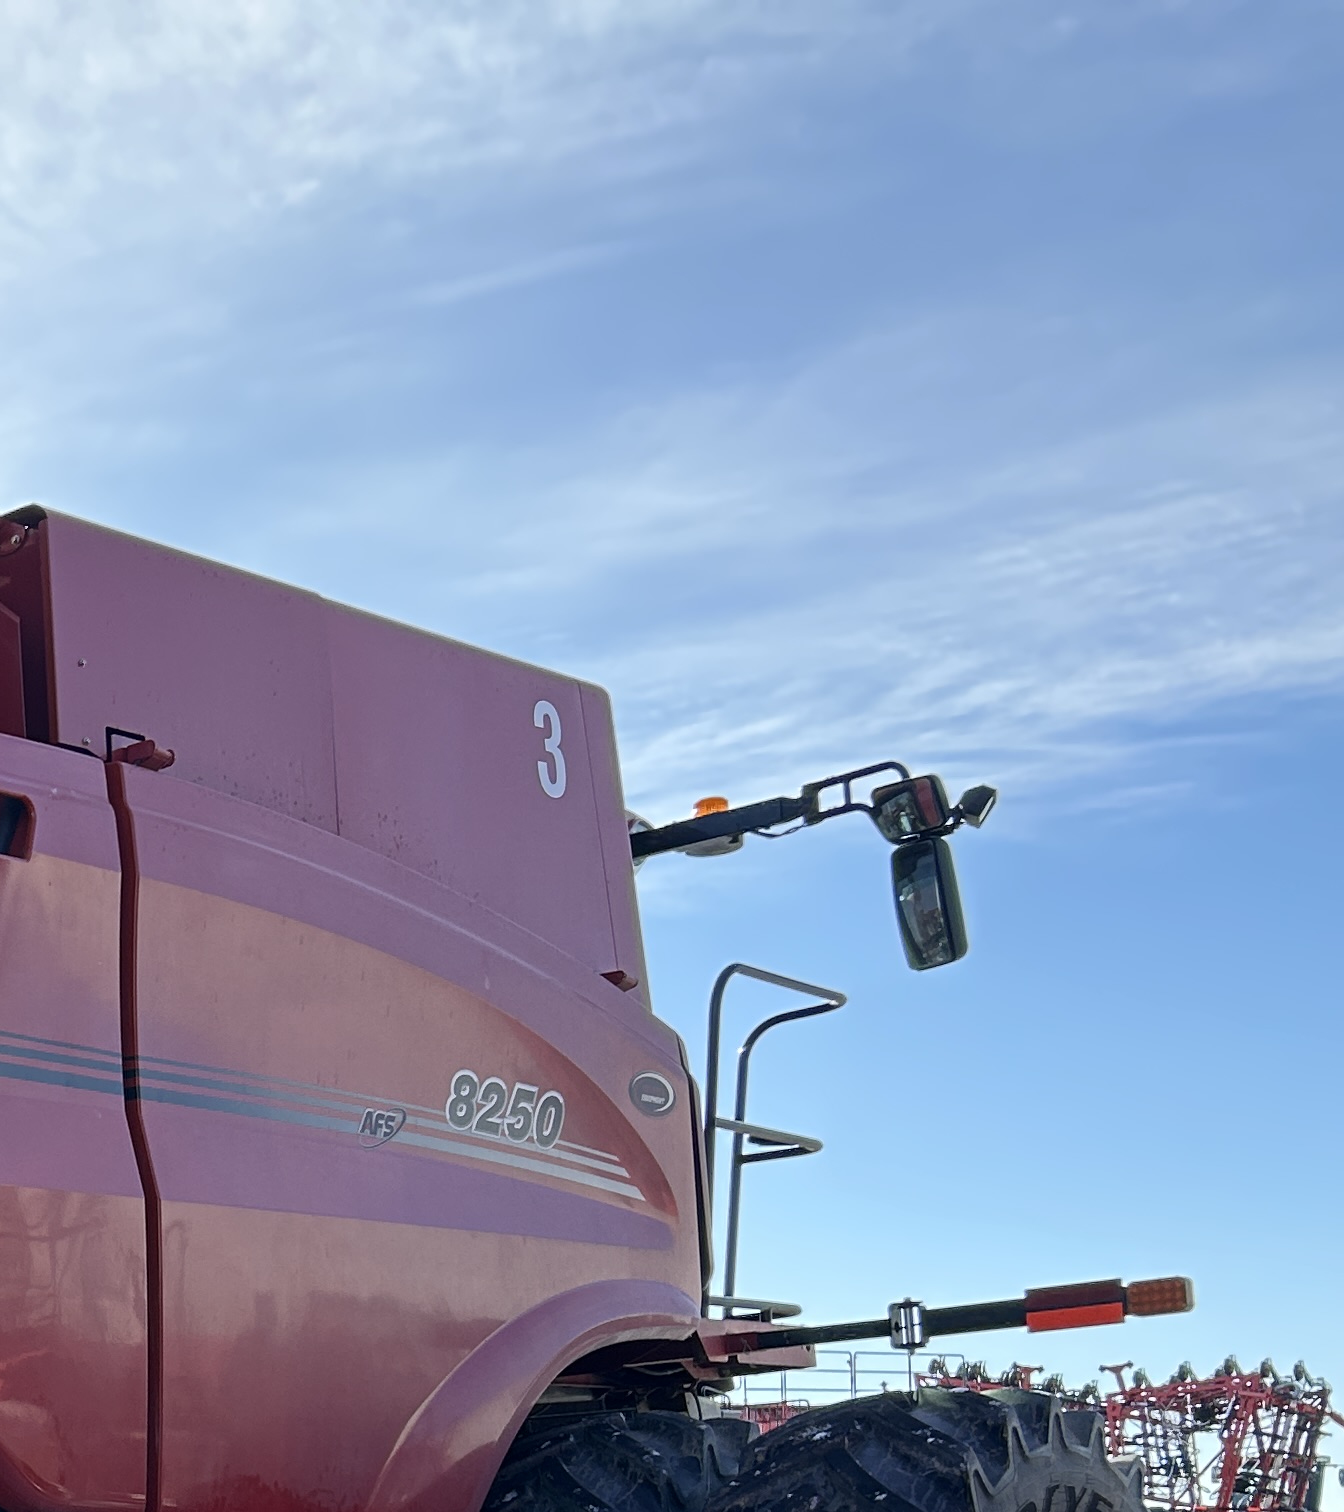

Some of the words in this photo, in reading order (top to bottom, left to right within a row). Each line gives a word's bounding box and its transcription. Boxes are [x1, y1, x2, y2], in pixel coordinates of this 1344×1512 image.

[533, 699, 567, 799] 3
[359, 1107, 399, 1139] AFS
[445, 1068, 566, 1150] 8250
